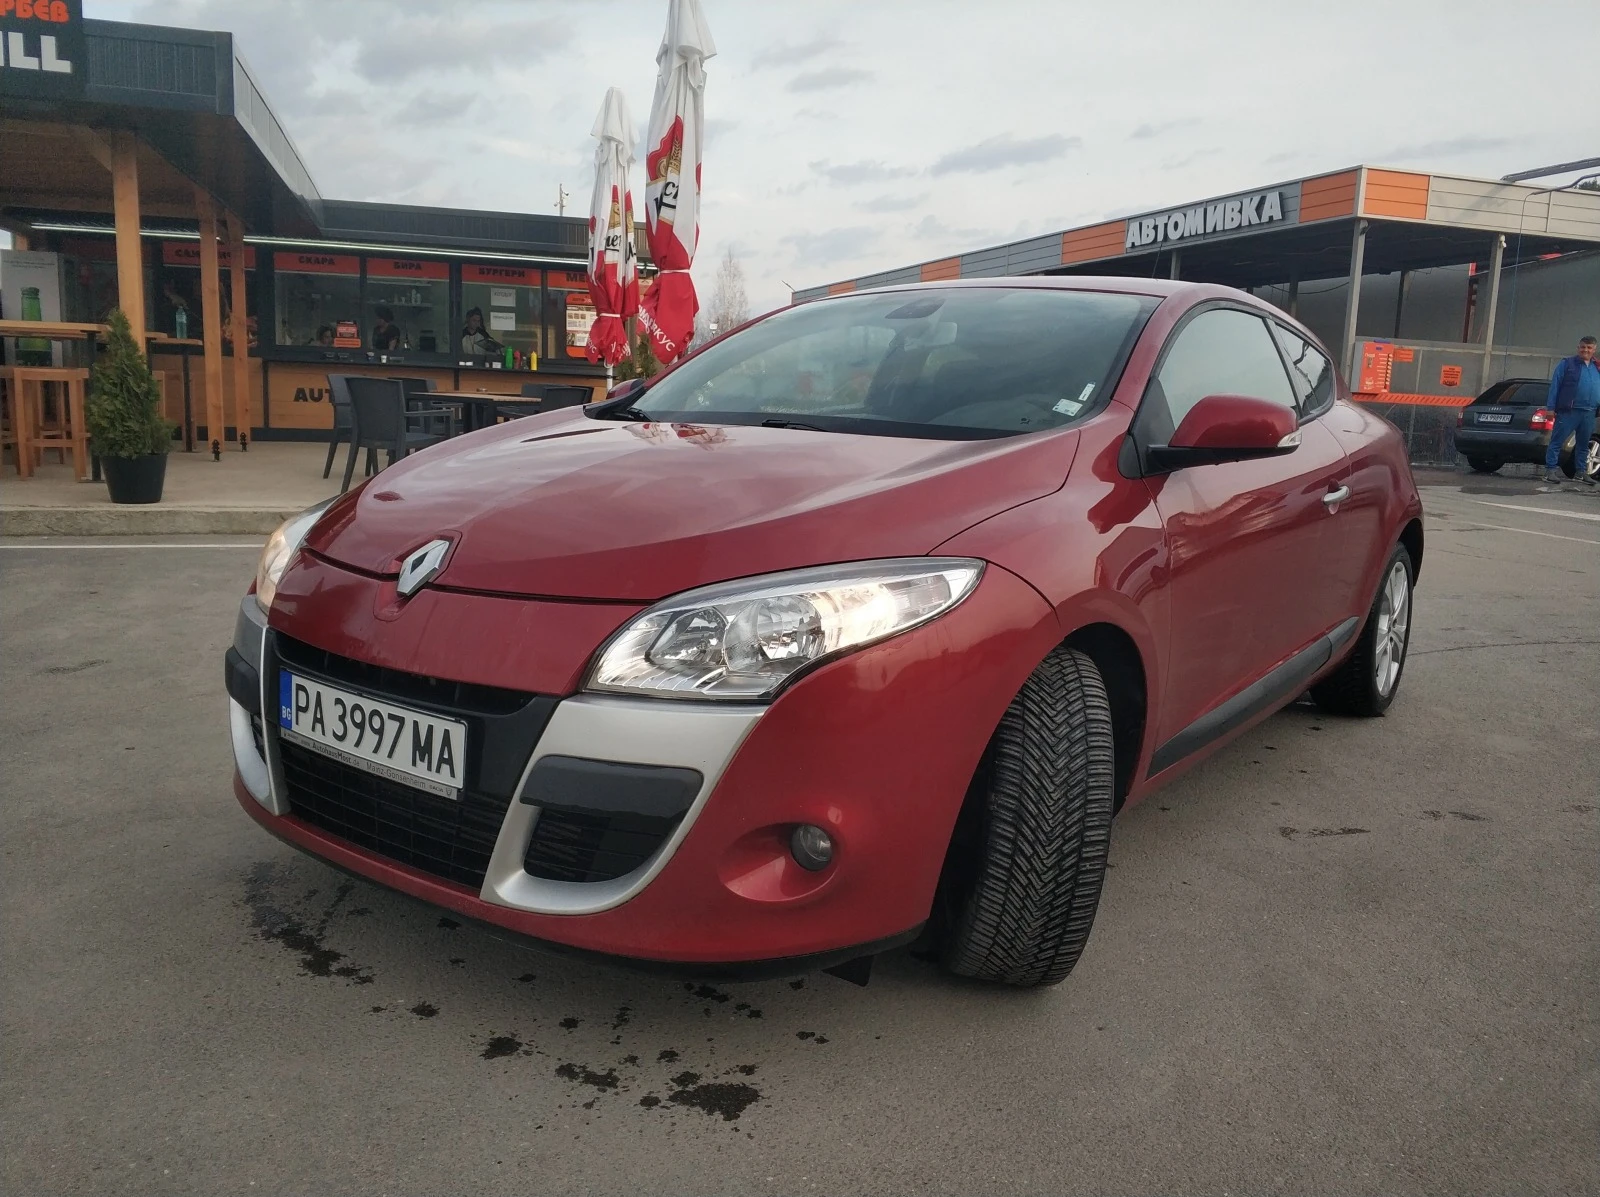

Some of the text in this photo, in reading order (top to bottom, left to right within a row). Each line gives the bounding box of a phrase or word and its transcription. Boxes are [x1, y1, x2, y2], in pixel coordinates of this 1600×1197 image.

[0, 31, 72, 73] LL
[1126, 191, 1282, 248] АВТОМИВКА
[298, 256, 335, 265] СКАРА
[393, 261, 422, 271] БИРА
[478, 267, 526, 278] БУРГЕРИ
[566, 272, 587, 282] МЕ
[282, 706, 291, 720] BG
[295, 683, 456, 778] PA 3997 MA
